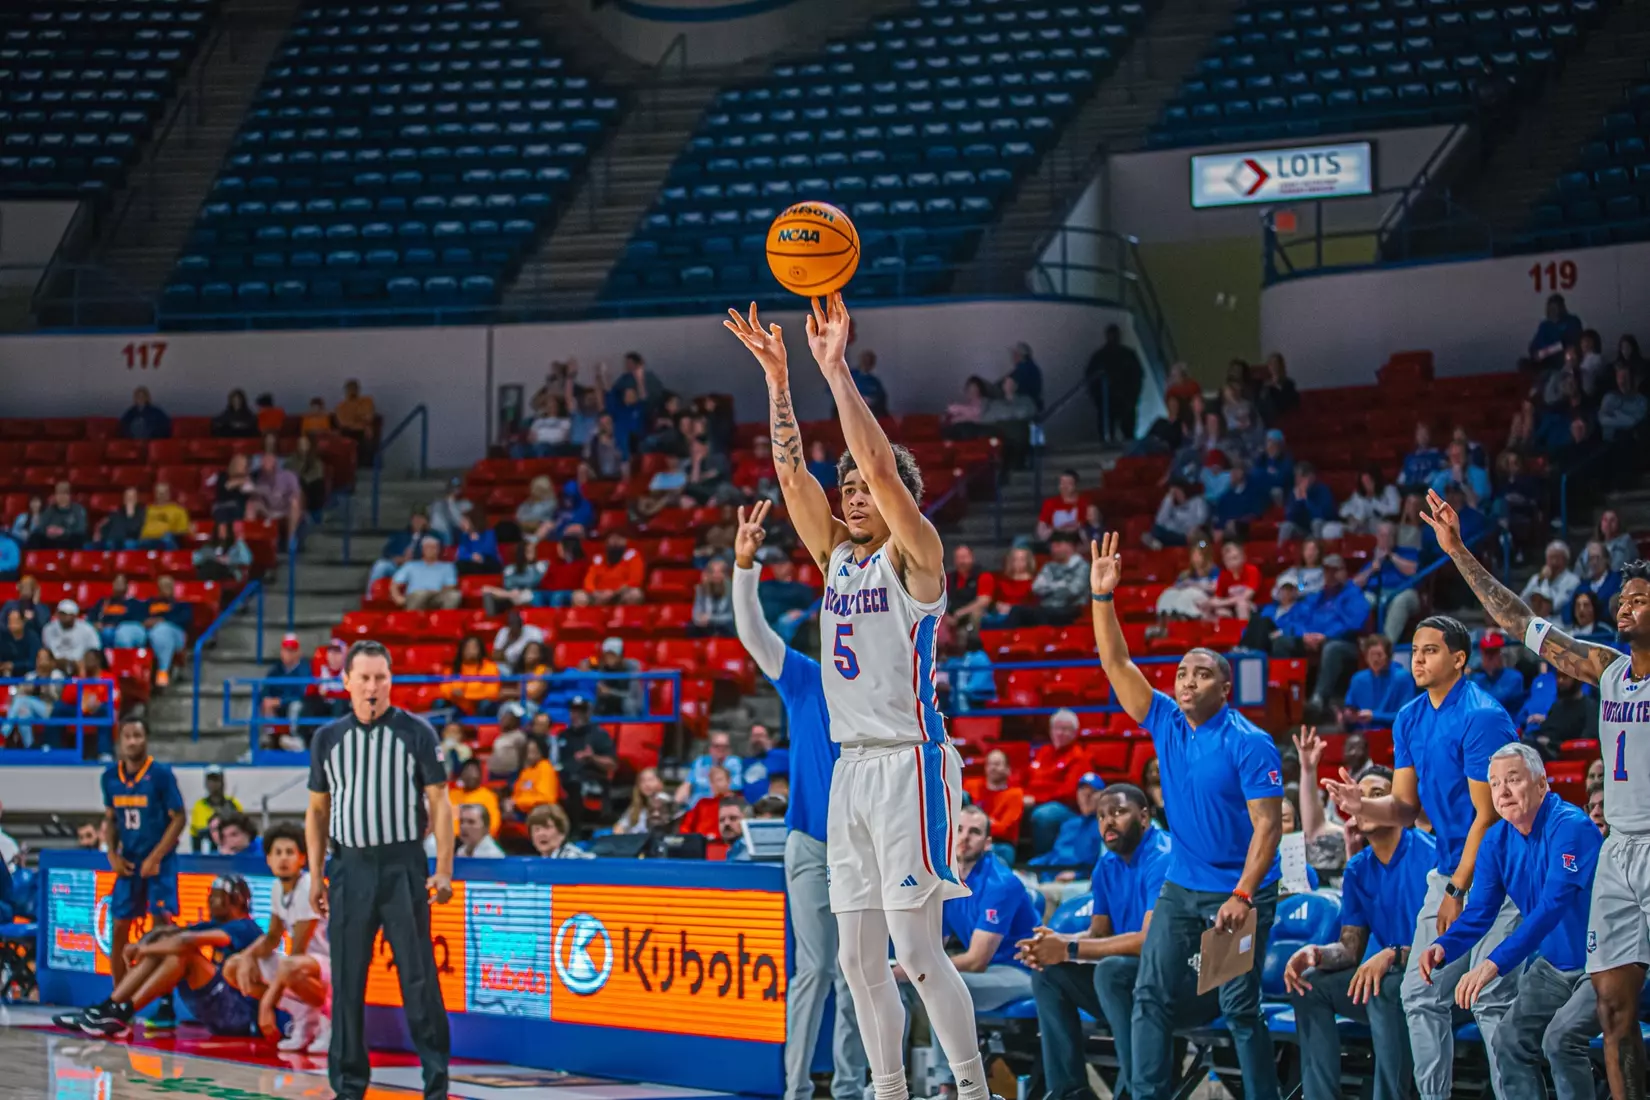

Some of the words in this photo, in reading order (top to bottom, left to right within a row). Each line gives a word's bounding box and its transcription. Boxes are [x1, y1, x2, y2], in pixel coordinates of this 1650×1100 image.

[1277, 152, 1341, 178] LOTS
[778, 229, 820, 244] NCAA
[1528, 260, 1578, 293] 119
[120, 342, 168, 370] 117
[834, 623, 860, 681] 5
[1613, 730, 1628, 781] 1
[124, 808, 141, 830] 13
[623, 927, 778, 1001] Kubota
